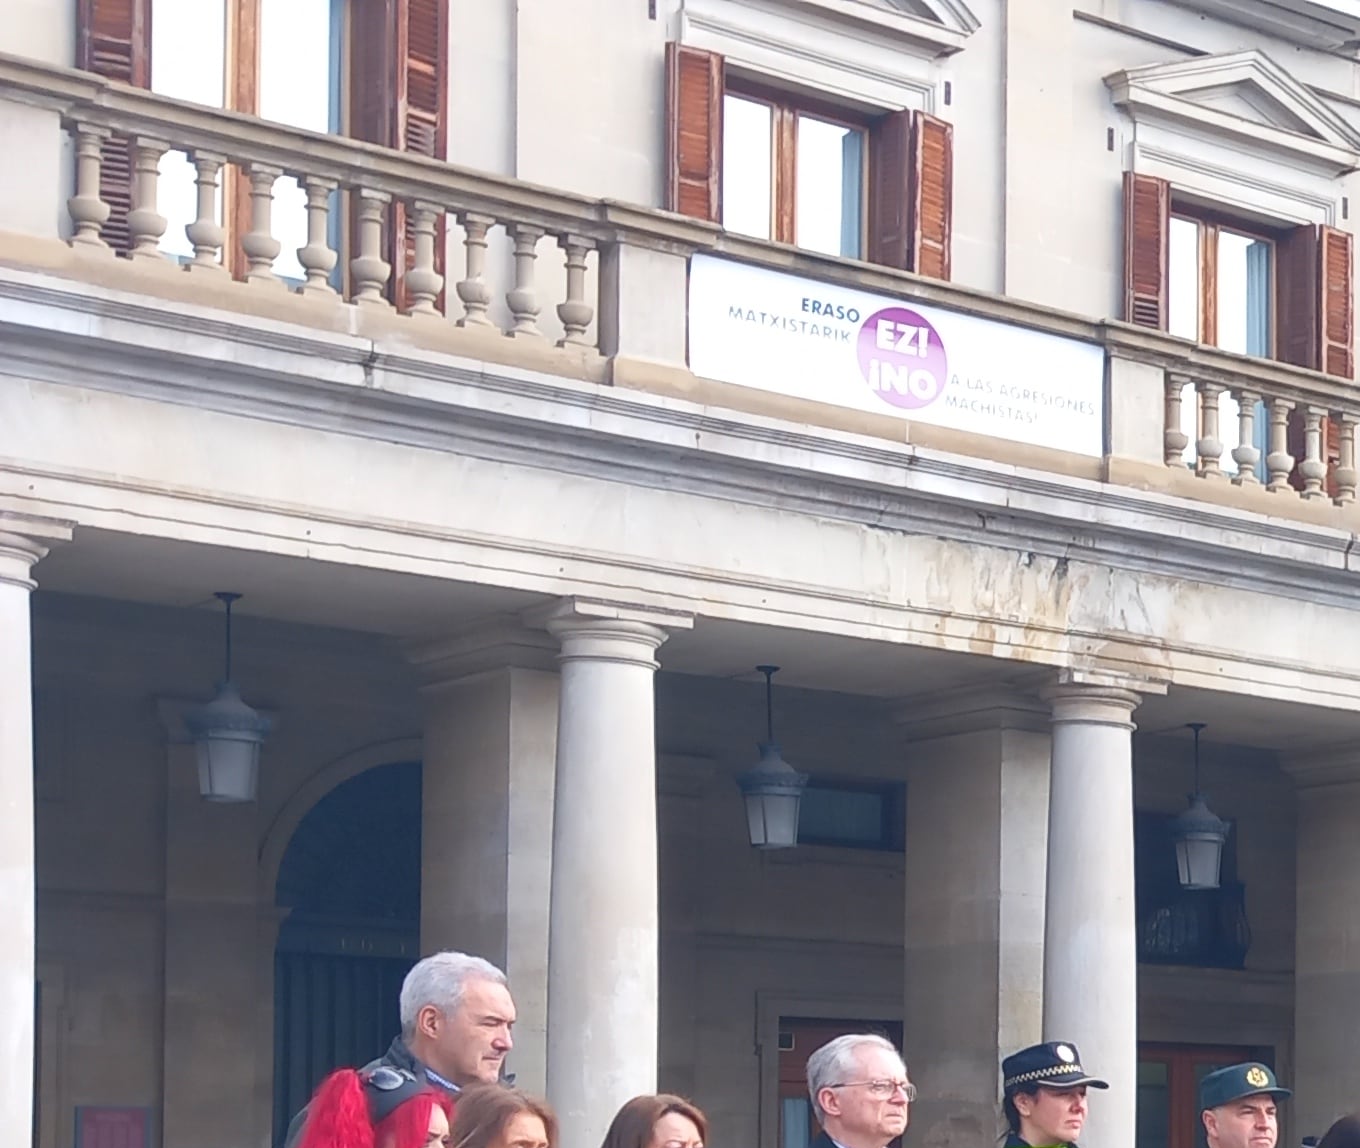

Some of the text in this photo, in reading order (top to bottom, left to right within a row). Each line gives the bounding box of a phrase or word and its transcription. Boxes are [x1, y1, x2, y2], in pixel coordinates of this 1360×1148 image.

[728, 305, 852, 343] MATXISTARIK
[801, 297, 860, 323] ERASO
[950, 373, 1095, 415] A LAS AGRESIONES
